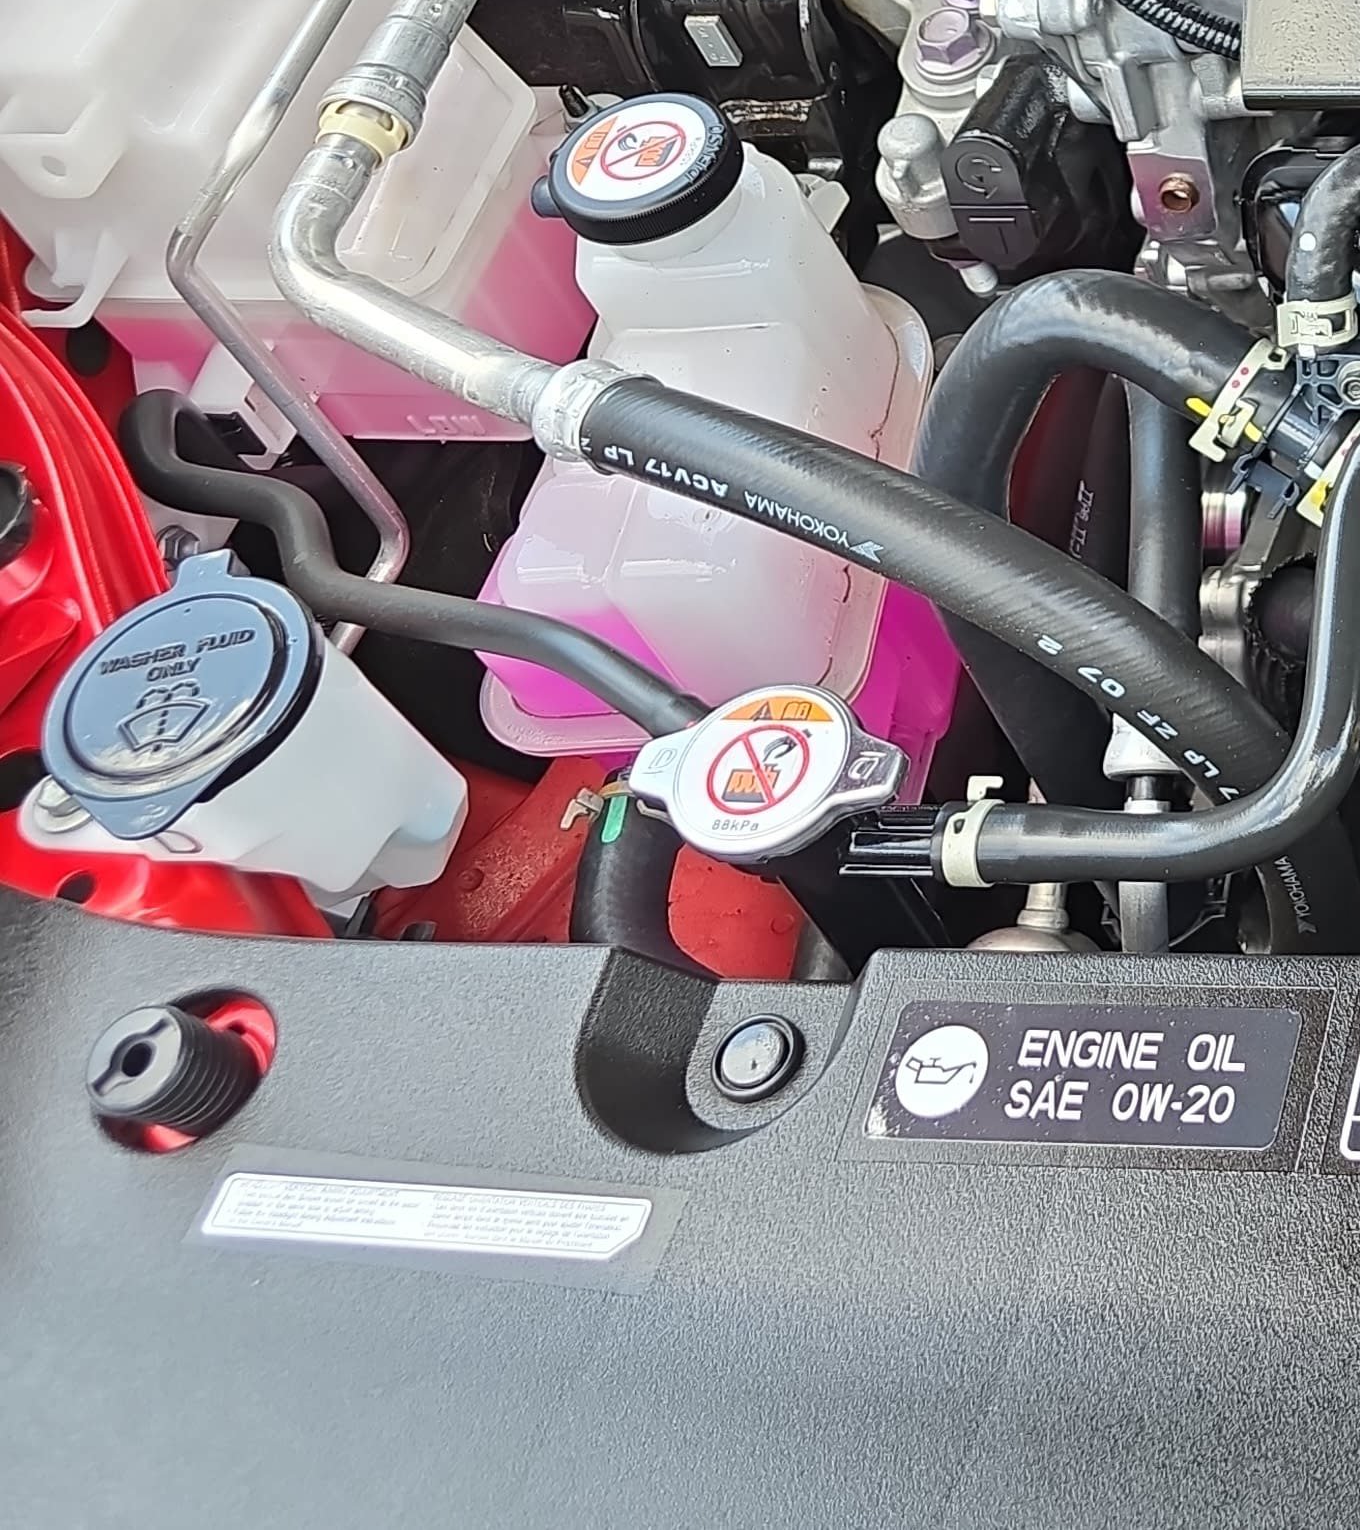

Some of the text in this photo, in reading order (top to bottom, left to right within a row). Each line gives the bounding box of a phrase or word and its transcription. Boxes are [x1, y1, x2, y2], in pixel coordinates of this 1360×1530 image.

[604, 445, 634, 466] LP
[645, 458, 728, 498] ACV17
[744, 490, 850, 548] YOKOHAMA
[101, 629, 256, 675] WASHER FLUID
[1037, 634, 1063, 656] 2
[146, 657, 201, 682] ONLY
[1077, 666, 1126, 698] 07
[1137, 709, 1178, 740] ZF
[1184, 749, 1220, 779] LP
[711, 819, 760, 831] 88kPa
[1274, 855, 1311, 918] YOKOHAMA
[1017, 1029, 1246, 1072] ENGINE OIL
[1004, 1080, 1236, 1123] SAE 0W-20
